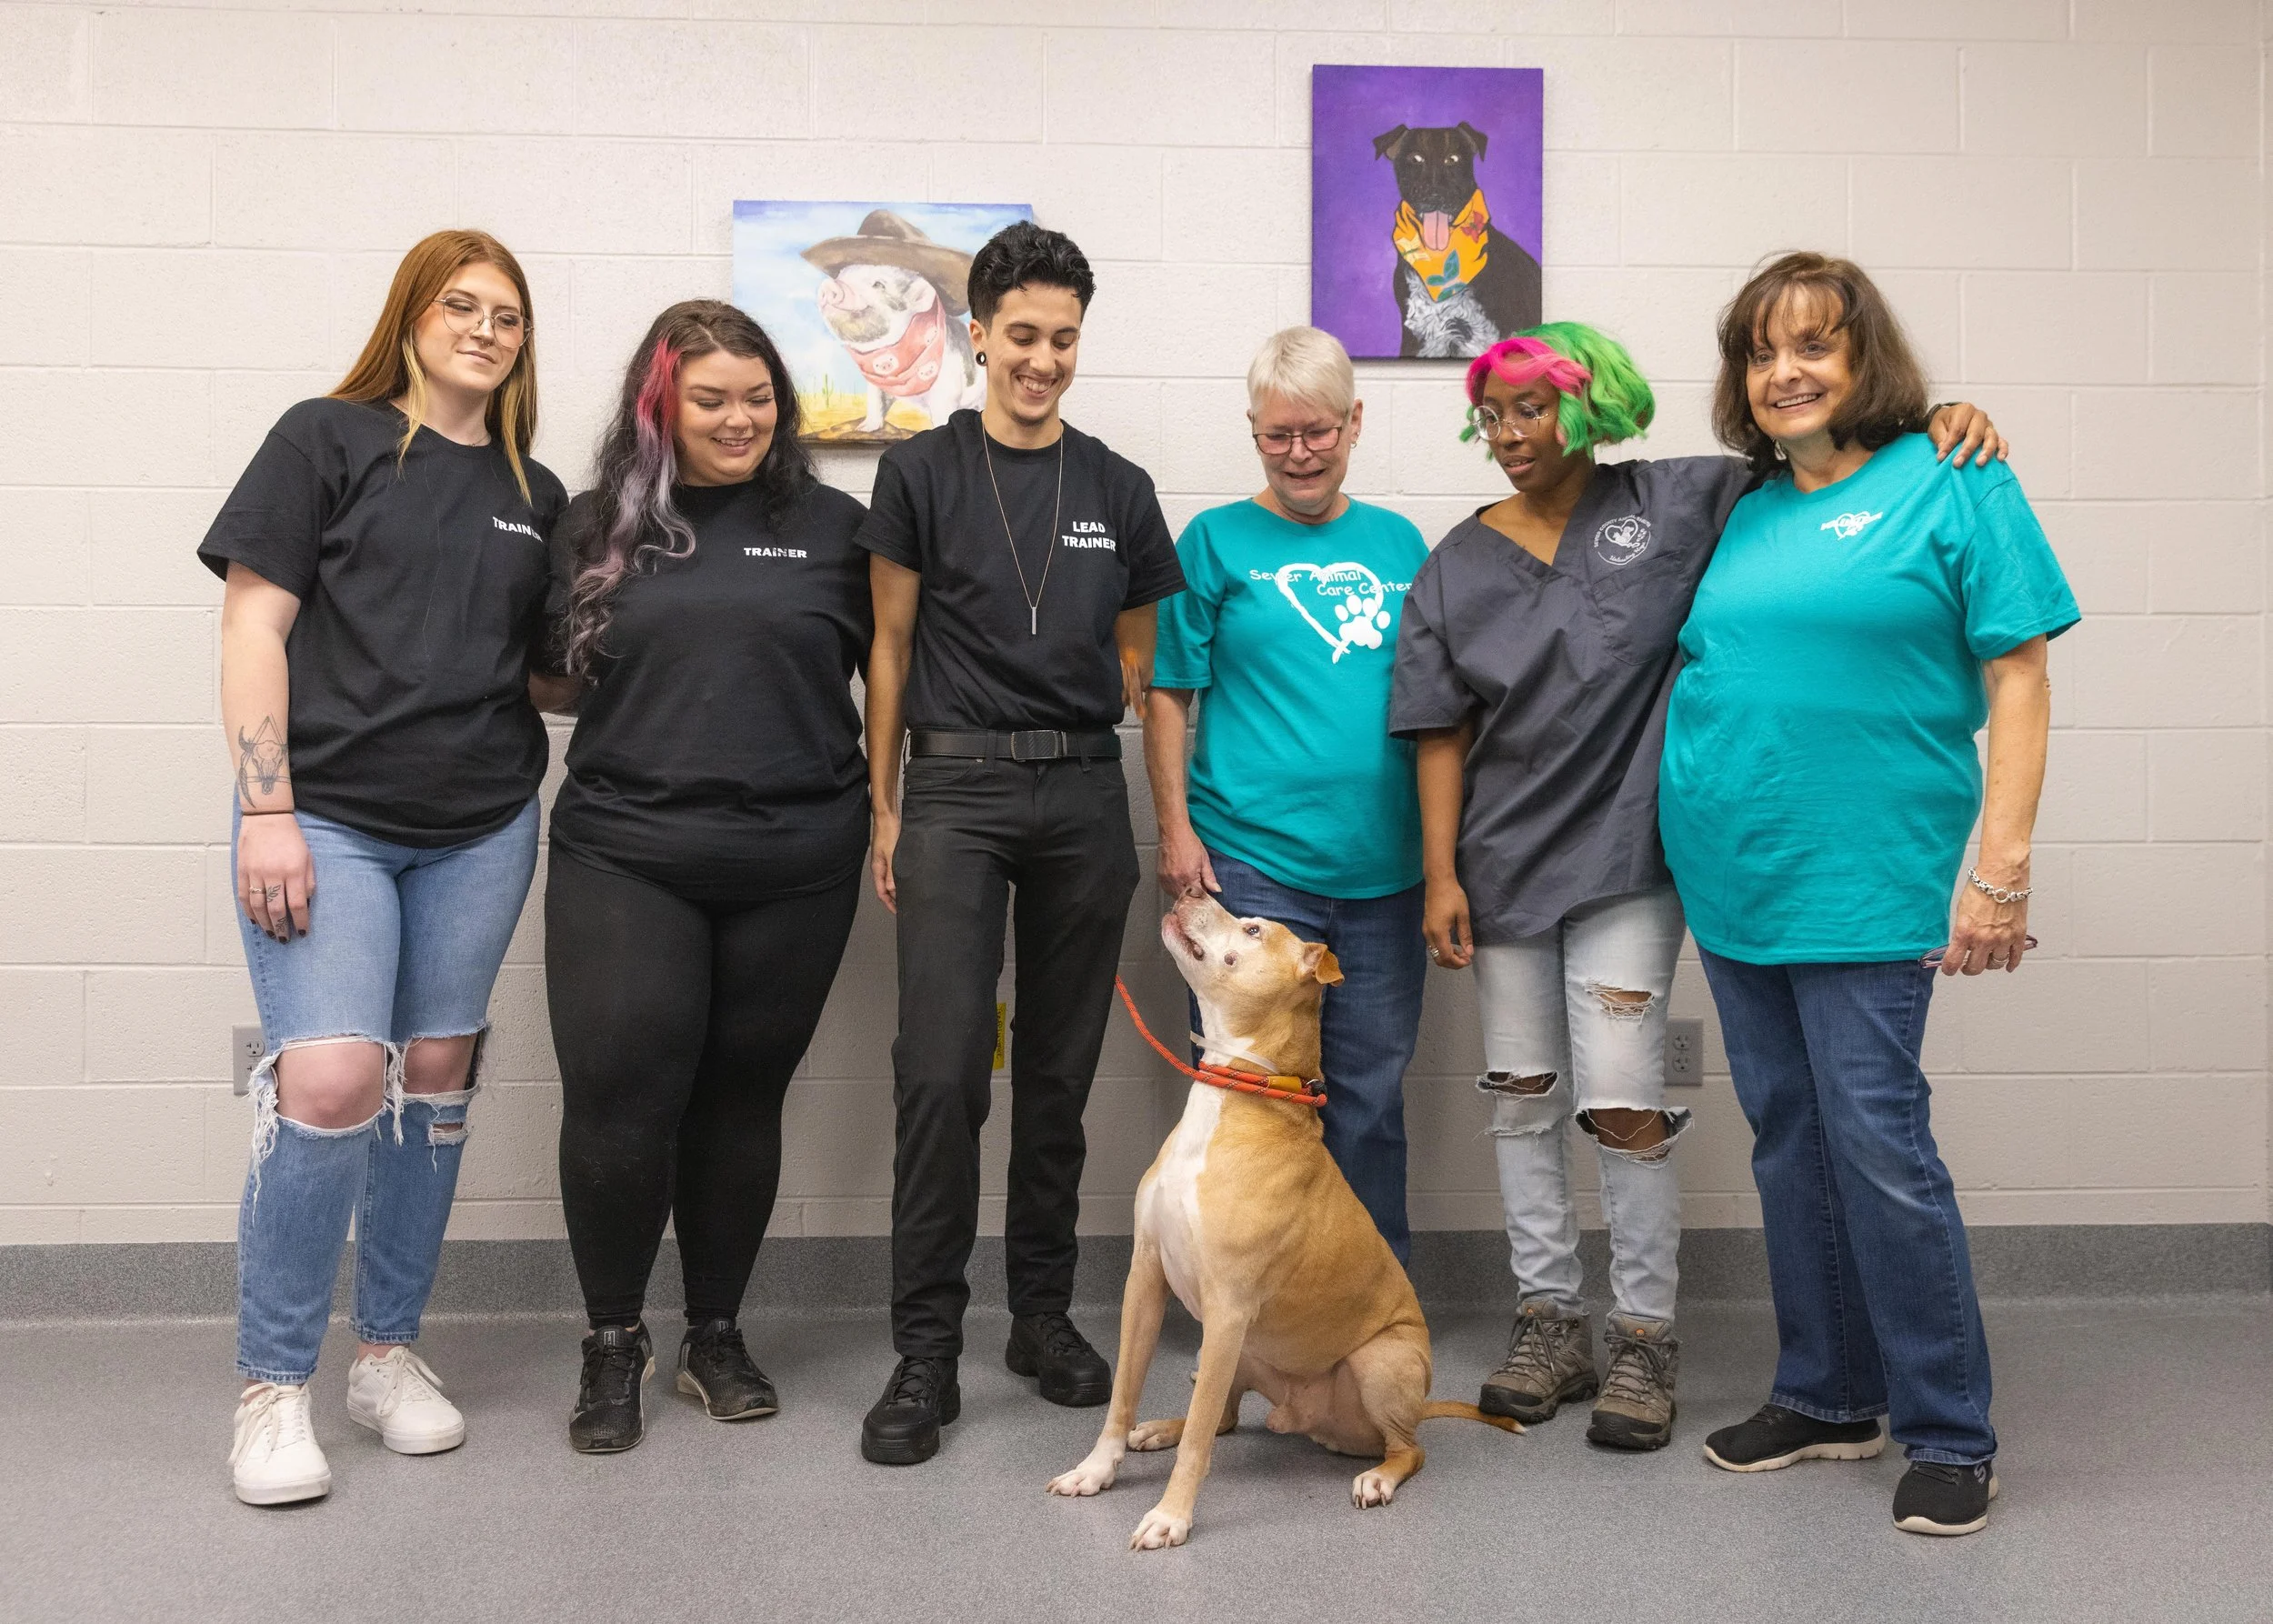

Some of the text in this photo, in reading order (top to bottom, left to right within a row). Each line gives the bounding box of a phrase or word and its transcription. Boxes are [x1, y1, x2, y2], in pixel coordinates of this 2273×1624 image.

[1072, 521, 1106, 533] LEAD
[1061, 535, 1116, 552] TRAINER
[743, 546, 807, 558] TRAINER
[1317, 583, 1355, 596] Care
